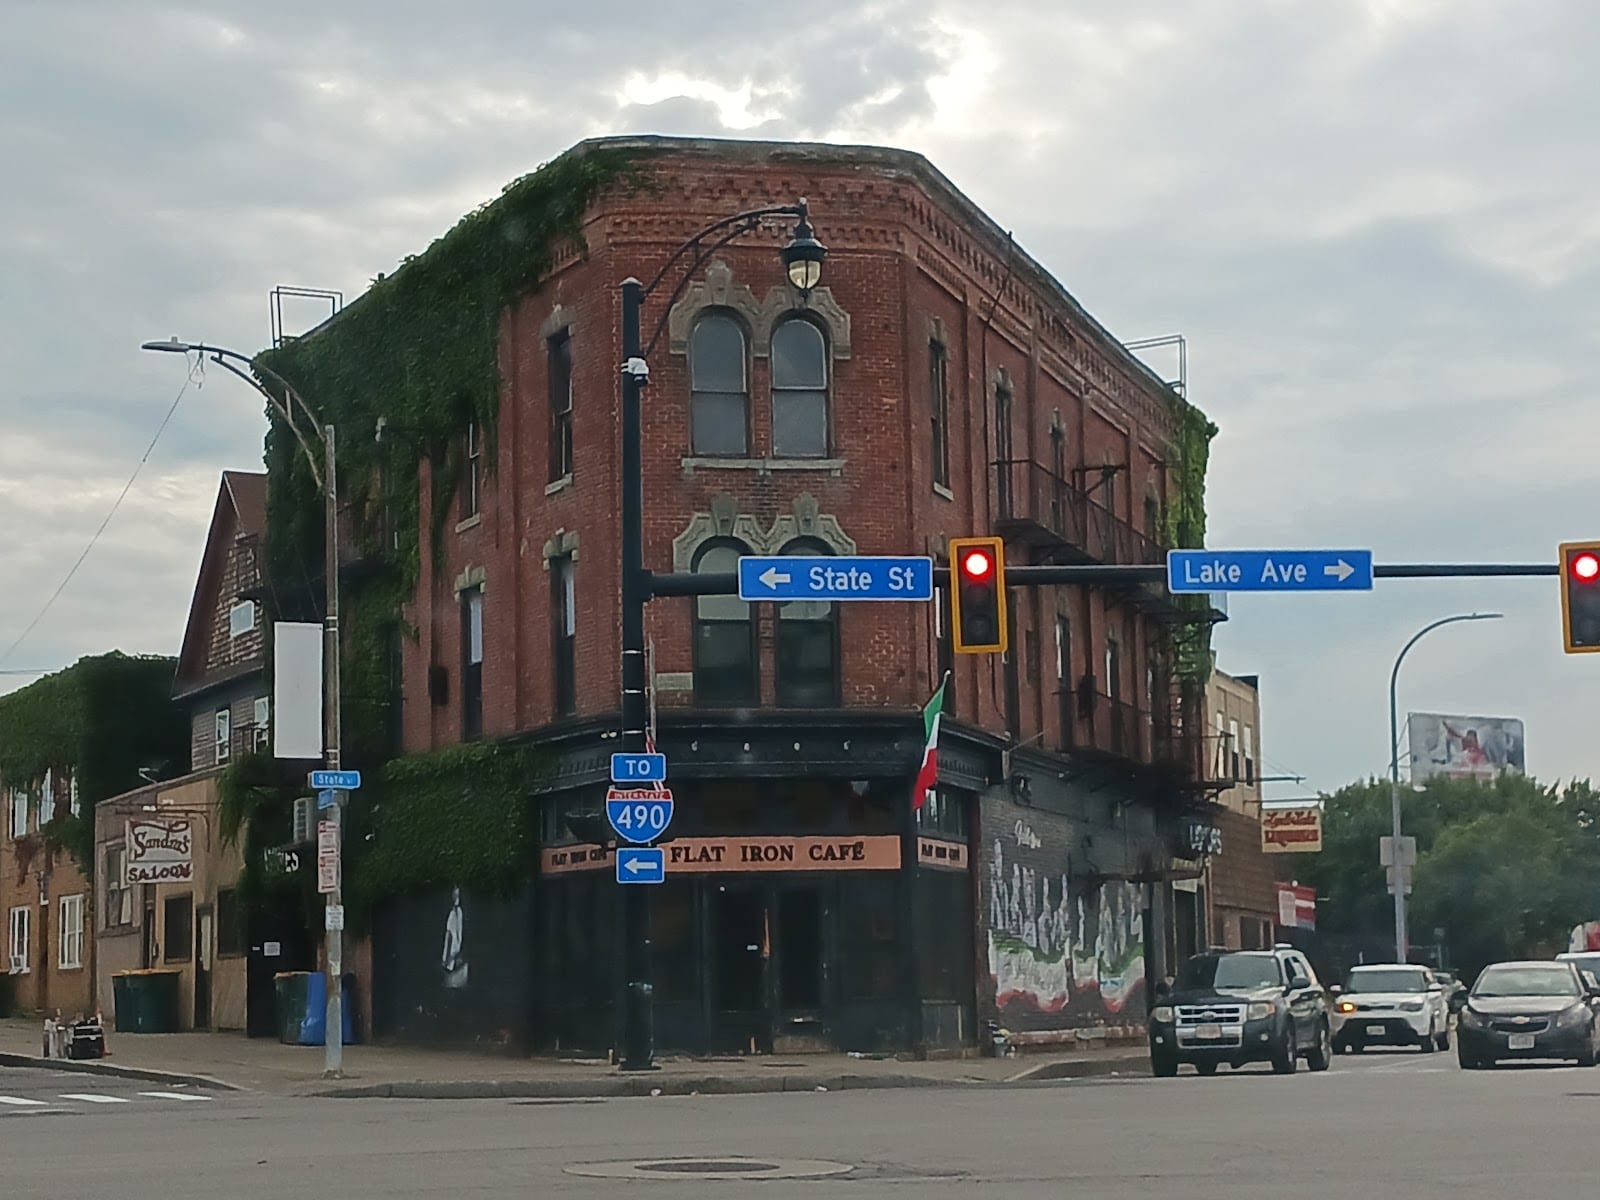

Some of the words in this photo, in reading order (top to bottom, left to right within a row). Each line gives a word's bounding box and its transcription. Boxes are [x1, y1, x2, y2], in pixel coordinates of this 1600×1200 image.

[809, 566, 873, 591] State
[888, 566, 915, 591] St
[1184, 559, 1242, 584] Lake
[1260, 558, 1307, 583] Ave
[625, 759, 651, 776] TO
[318, 774, 344, 785] State
[616, 804, 665, 829] 490
[670, 845, 726, 863] FLAT
[740, 844, 794, 862] IRON
[127, 863, 192, 882] SALOON
